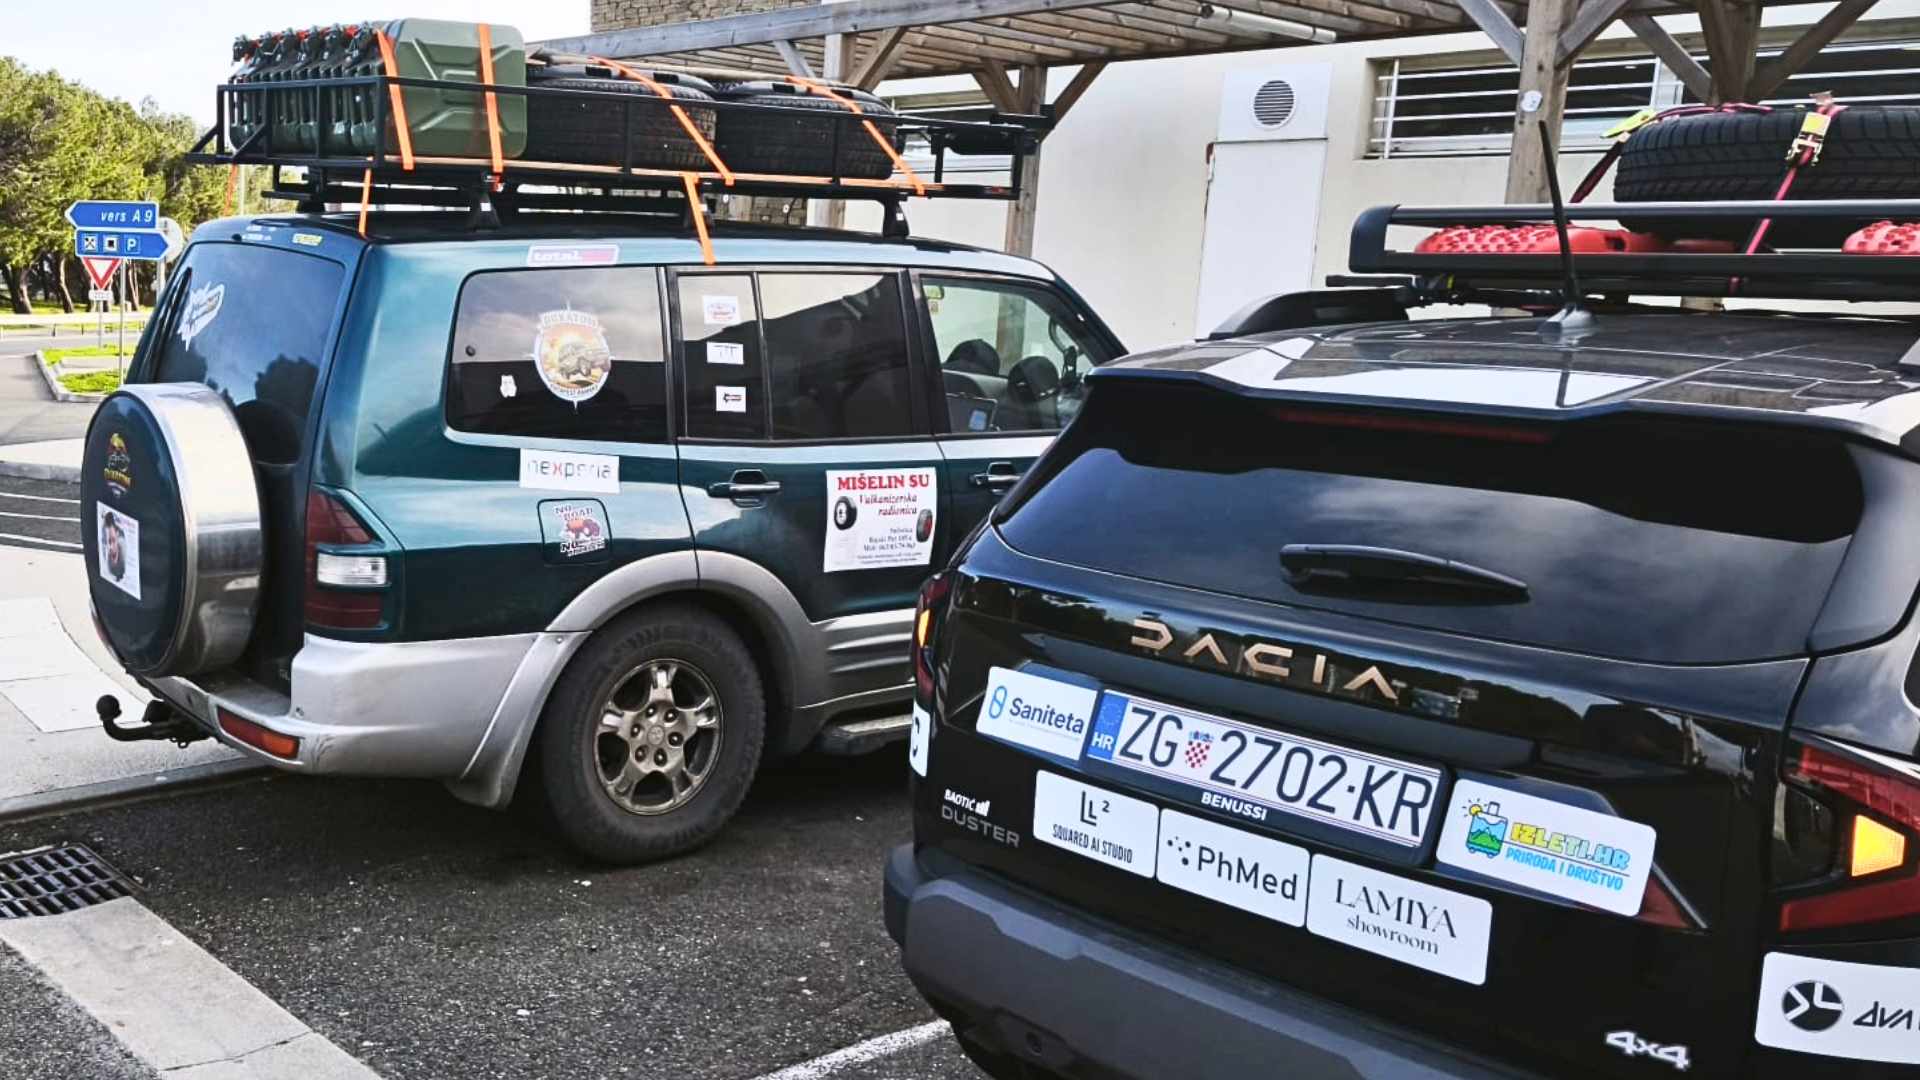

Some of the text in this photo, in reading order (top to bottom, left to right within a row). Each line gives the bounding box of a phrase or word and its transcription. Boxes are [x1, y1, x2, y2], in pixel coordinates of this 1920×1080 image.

[101, 211, 126, 221] vers
[528, 459, 611, 480] nexperia
[837, 473, 929, 490] MIŠELIN SU
[879, 504, 917, 515] radionica
[1131, 618, 1398, 699] DACIA
[1009, 697, 1084, 734] Saniteta
[1091, 732, 1114, 750] HR
[1118, 706, 1184, 768] ZG
[1201, 791, 1268, 821] BENUSSI
[941, 805, 1020, 848] DUSTER
[1052, 823, 1133, 864] SQUARED AI STUDIO
[1510, 821, 1632, 871] IZLETI.HR
[1198, 845, 1298, 901] PhMed
[1506, 847, 1556, 873] PRIRODA
[1566, 862, 1624, 892] DRUŠTVO
[1335, 878, 1457, 938] LAMIYA
[1347, 914, 1439, 954] showroom
[1605, 1031, 1691, 1070] 4x4
